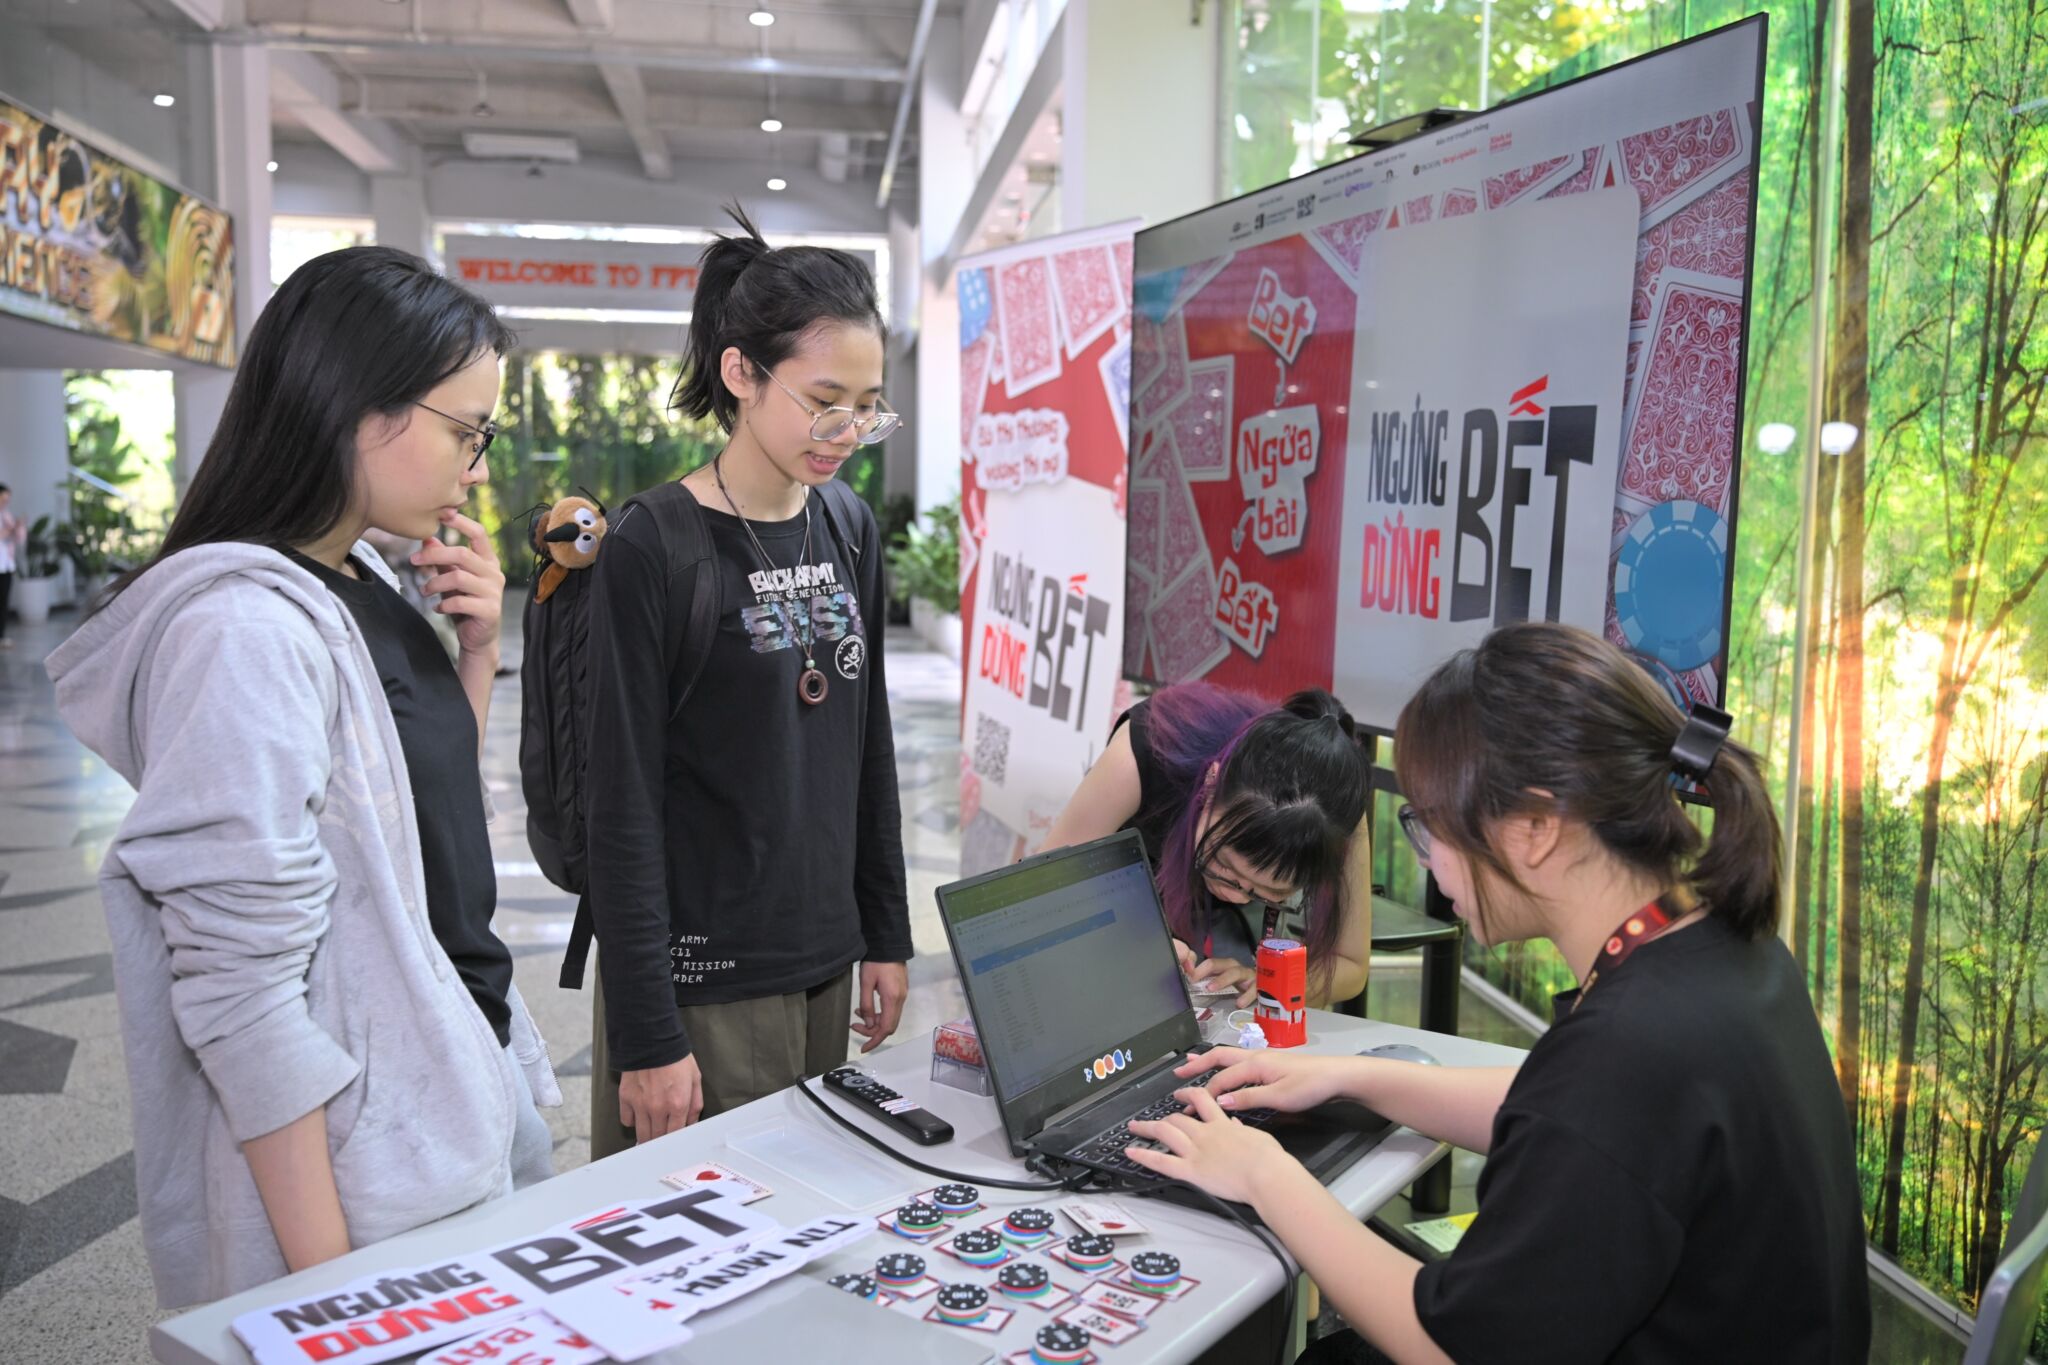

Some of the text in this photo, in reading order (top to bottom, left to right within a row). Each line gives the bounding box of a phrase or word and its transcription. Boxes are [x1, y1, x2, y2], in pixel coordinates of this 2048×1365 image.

[458, 258, 597, 286] WELCOME
[606, 263, 641, 287] TO
[1252, 274, 1309, 356] Bet
[1258, 496, 1296, 540] bài
[1216, 570, 1273, 650] Bết
[680, 935, 709, 944] ARMY
[682, 960, 736, 971] MISSION
